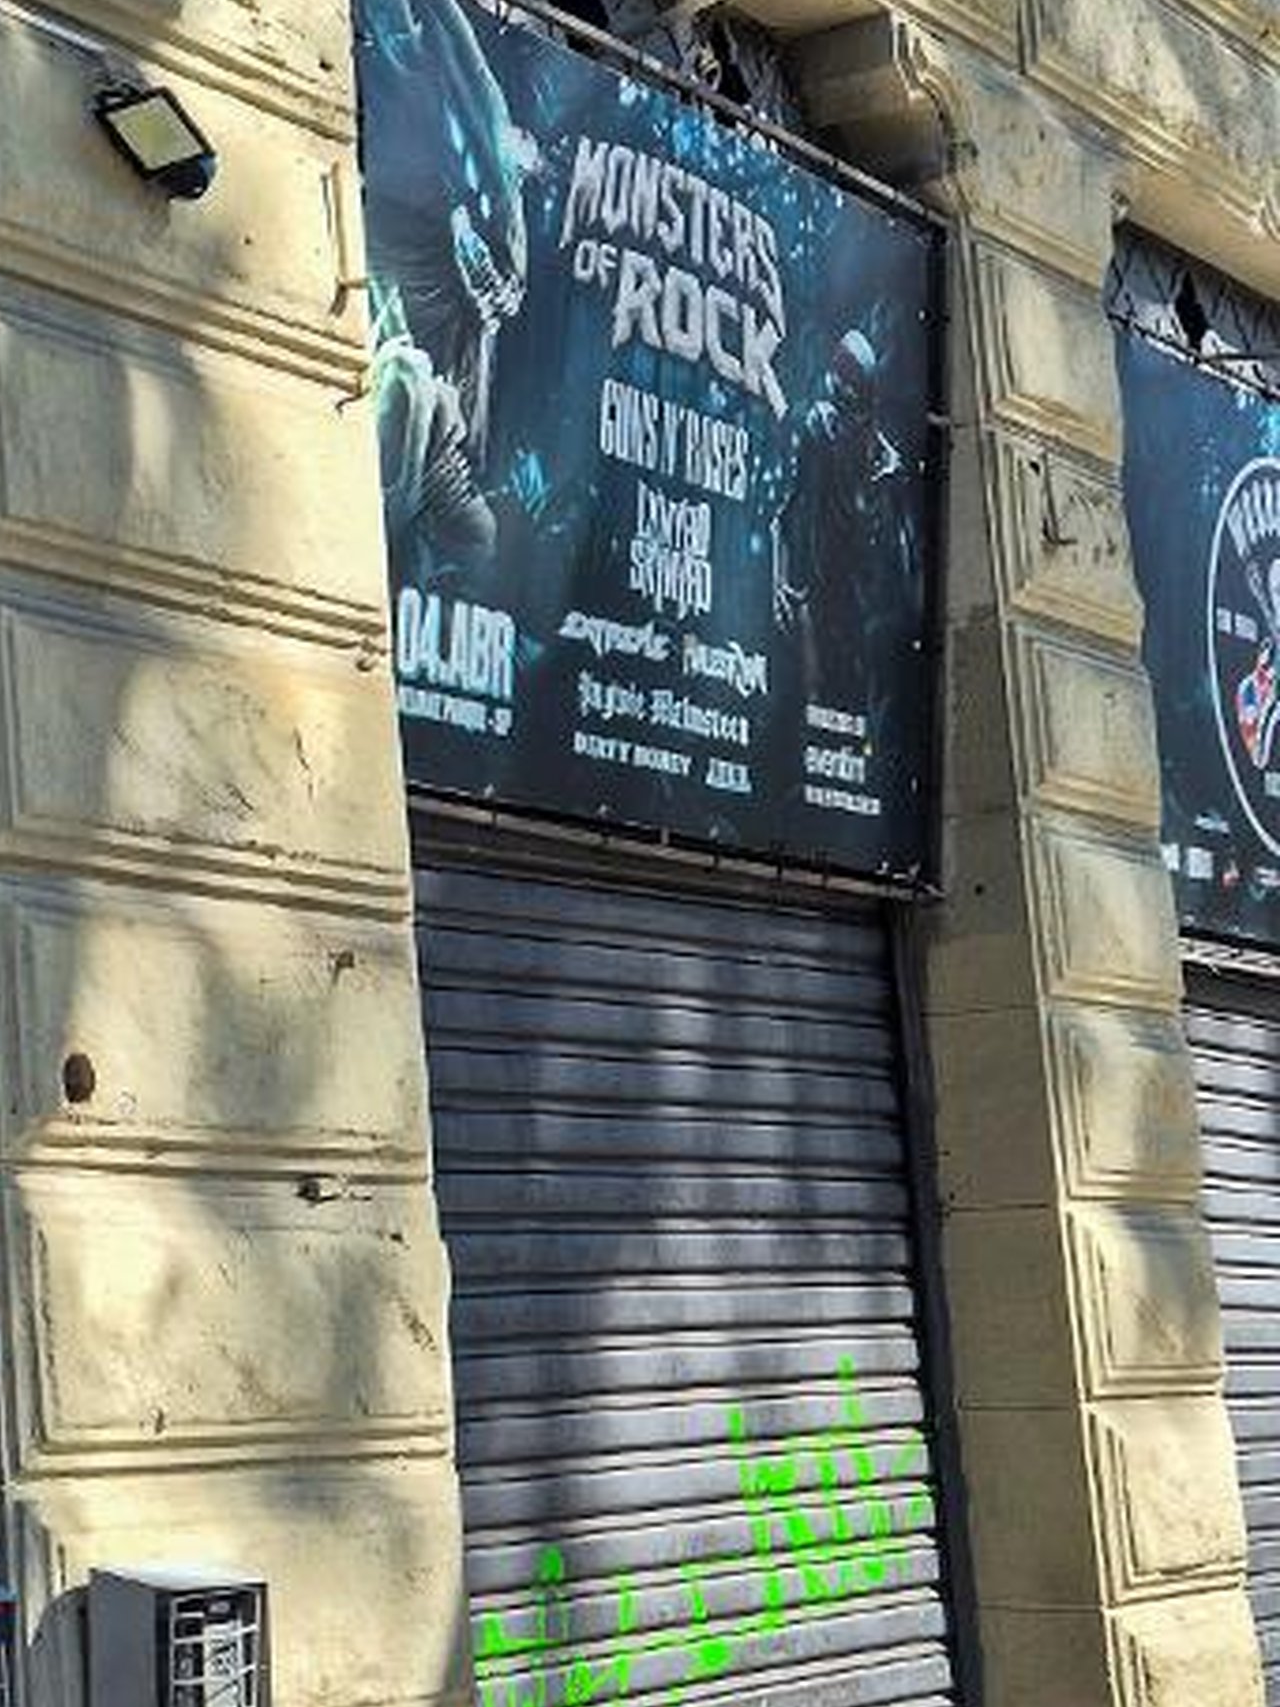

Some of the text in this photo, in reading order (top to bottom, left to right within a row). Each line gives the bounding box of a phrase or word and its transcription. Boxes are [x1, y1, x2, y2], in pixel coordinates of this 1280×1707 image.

[559, 136, 786, 338] MONSTERS
[573, 241, 788, 423] OF ROCK
